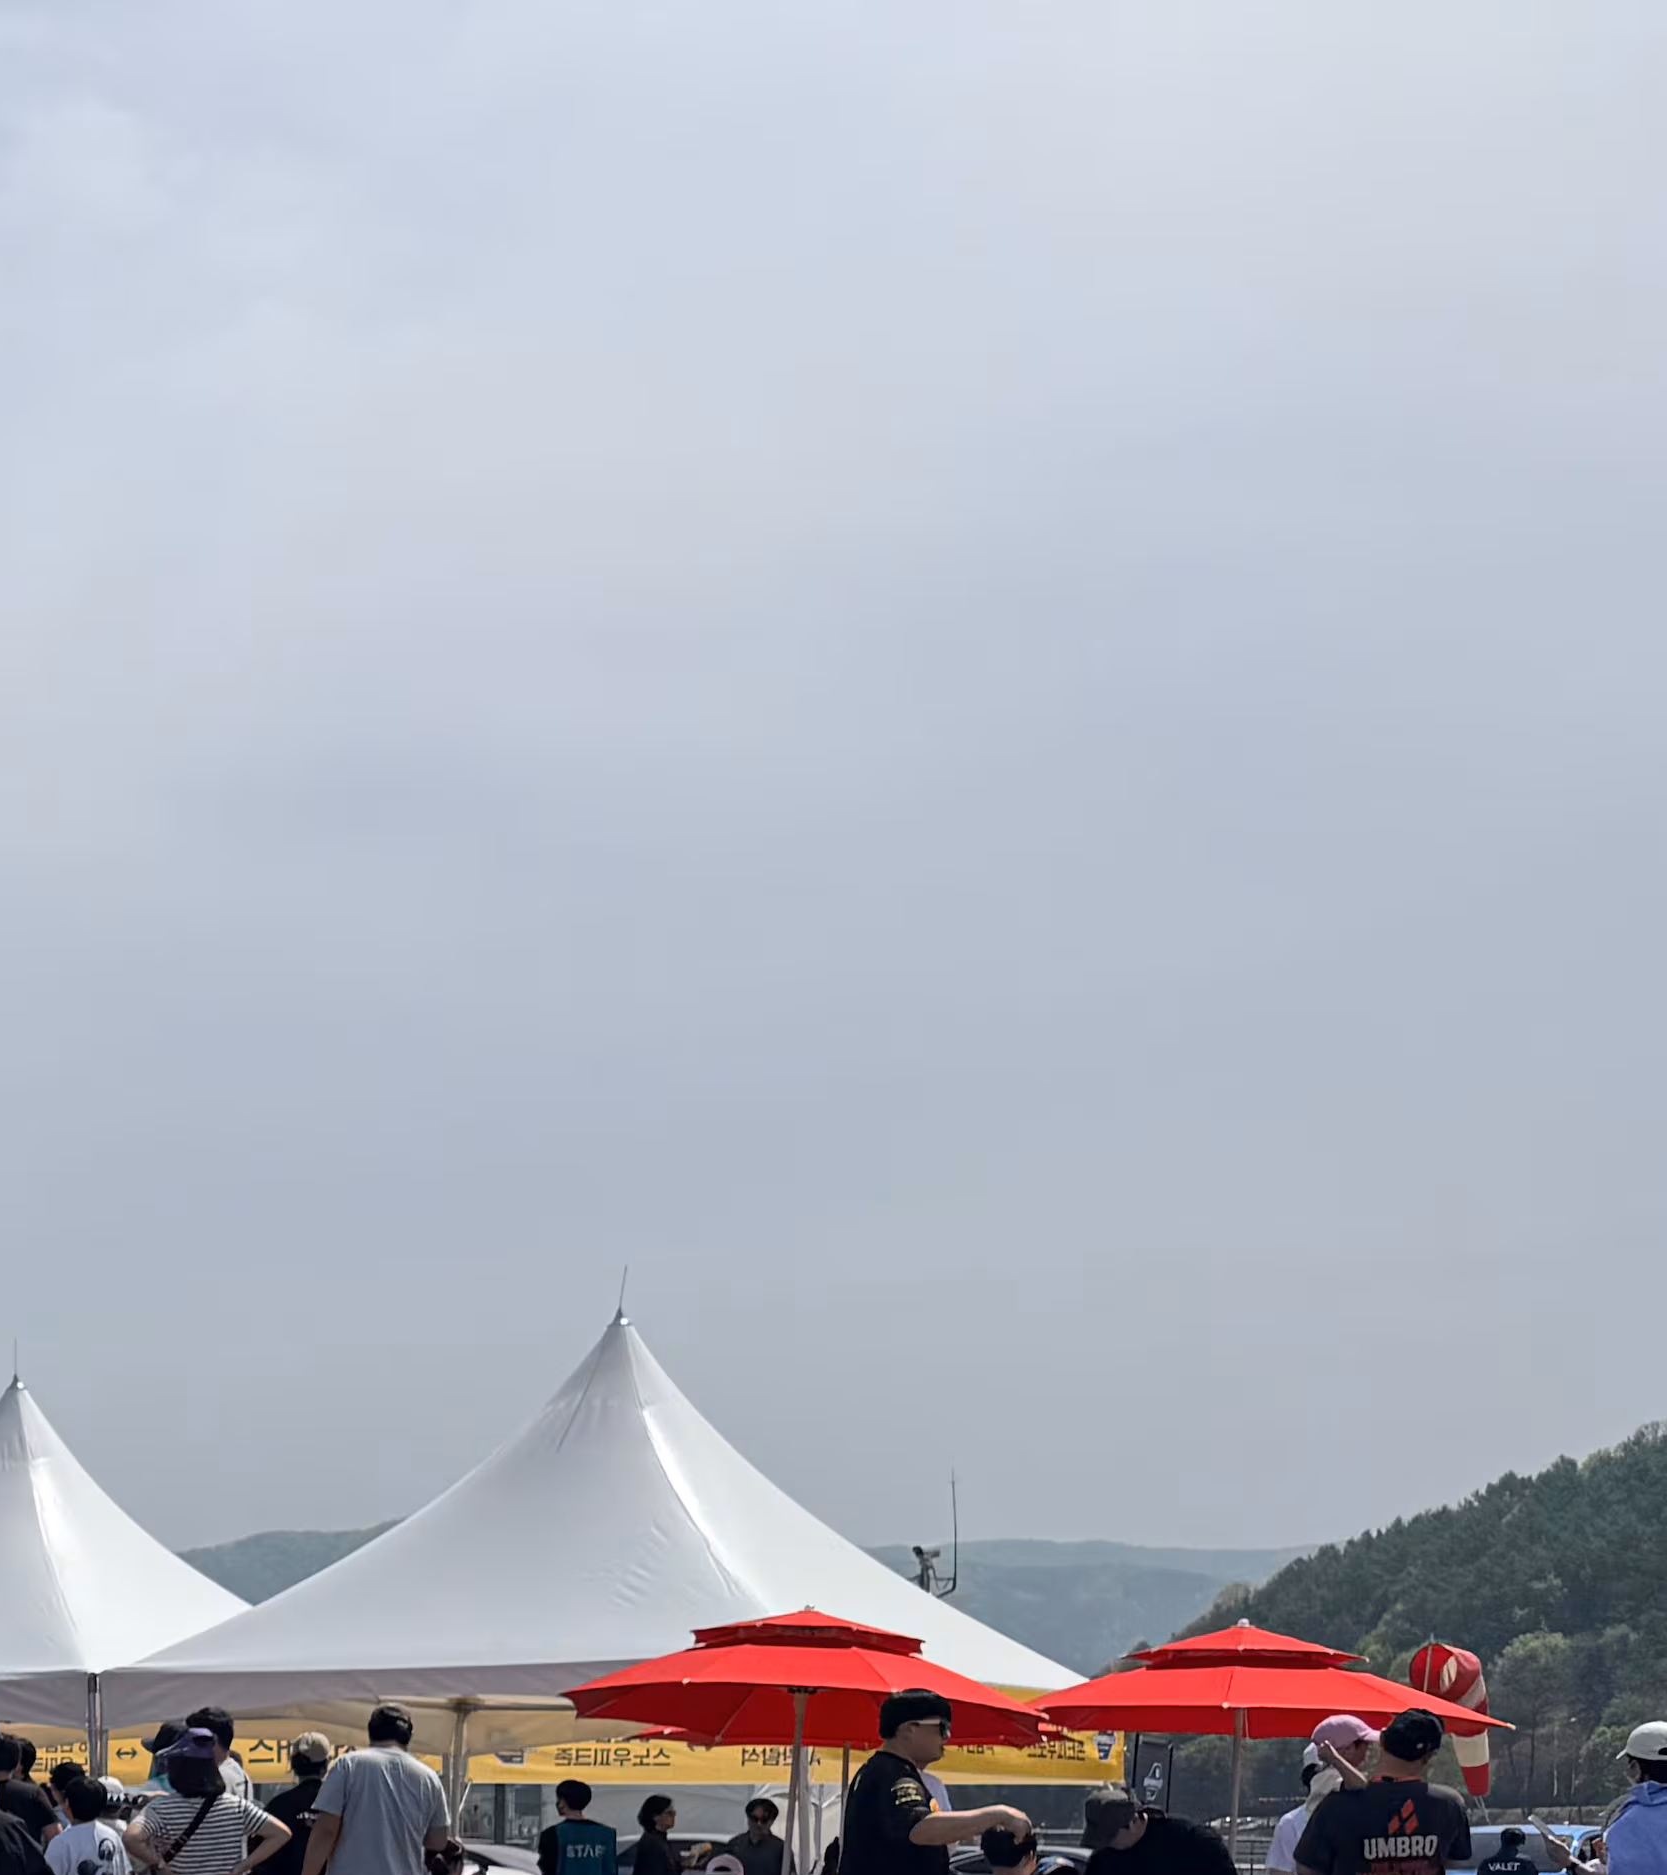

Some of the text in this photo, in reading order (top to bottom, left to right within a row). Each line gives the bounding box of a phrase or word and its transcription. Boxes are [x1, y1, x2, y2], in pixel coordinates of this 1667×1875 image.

[566, 1844, 605, 1859] STAF
[1363, 1834, 1438, 1860] UMBRO
[1487, 1862, 1521, 1872] VALET
